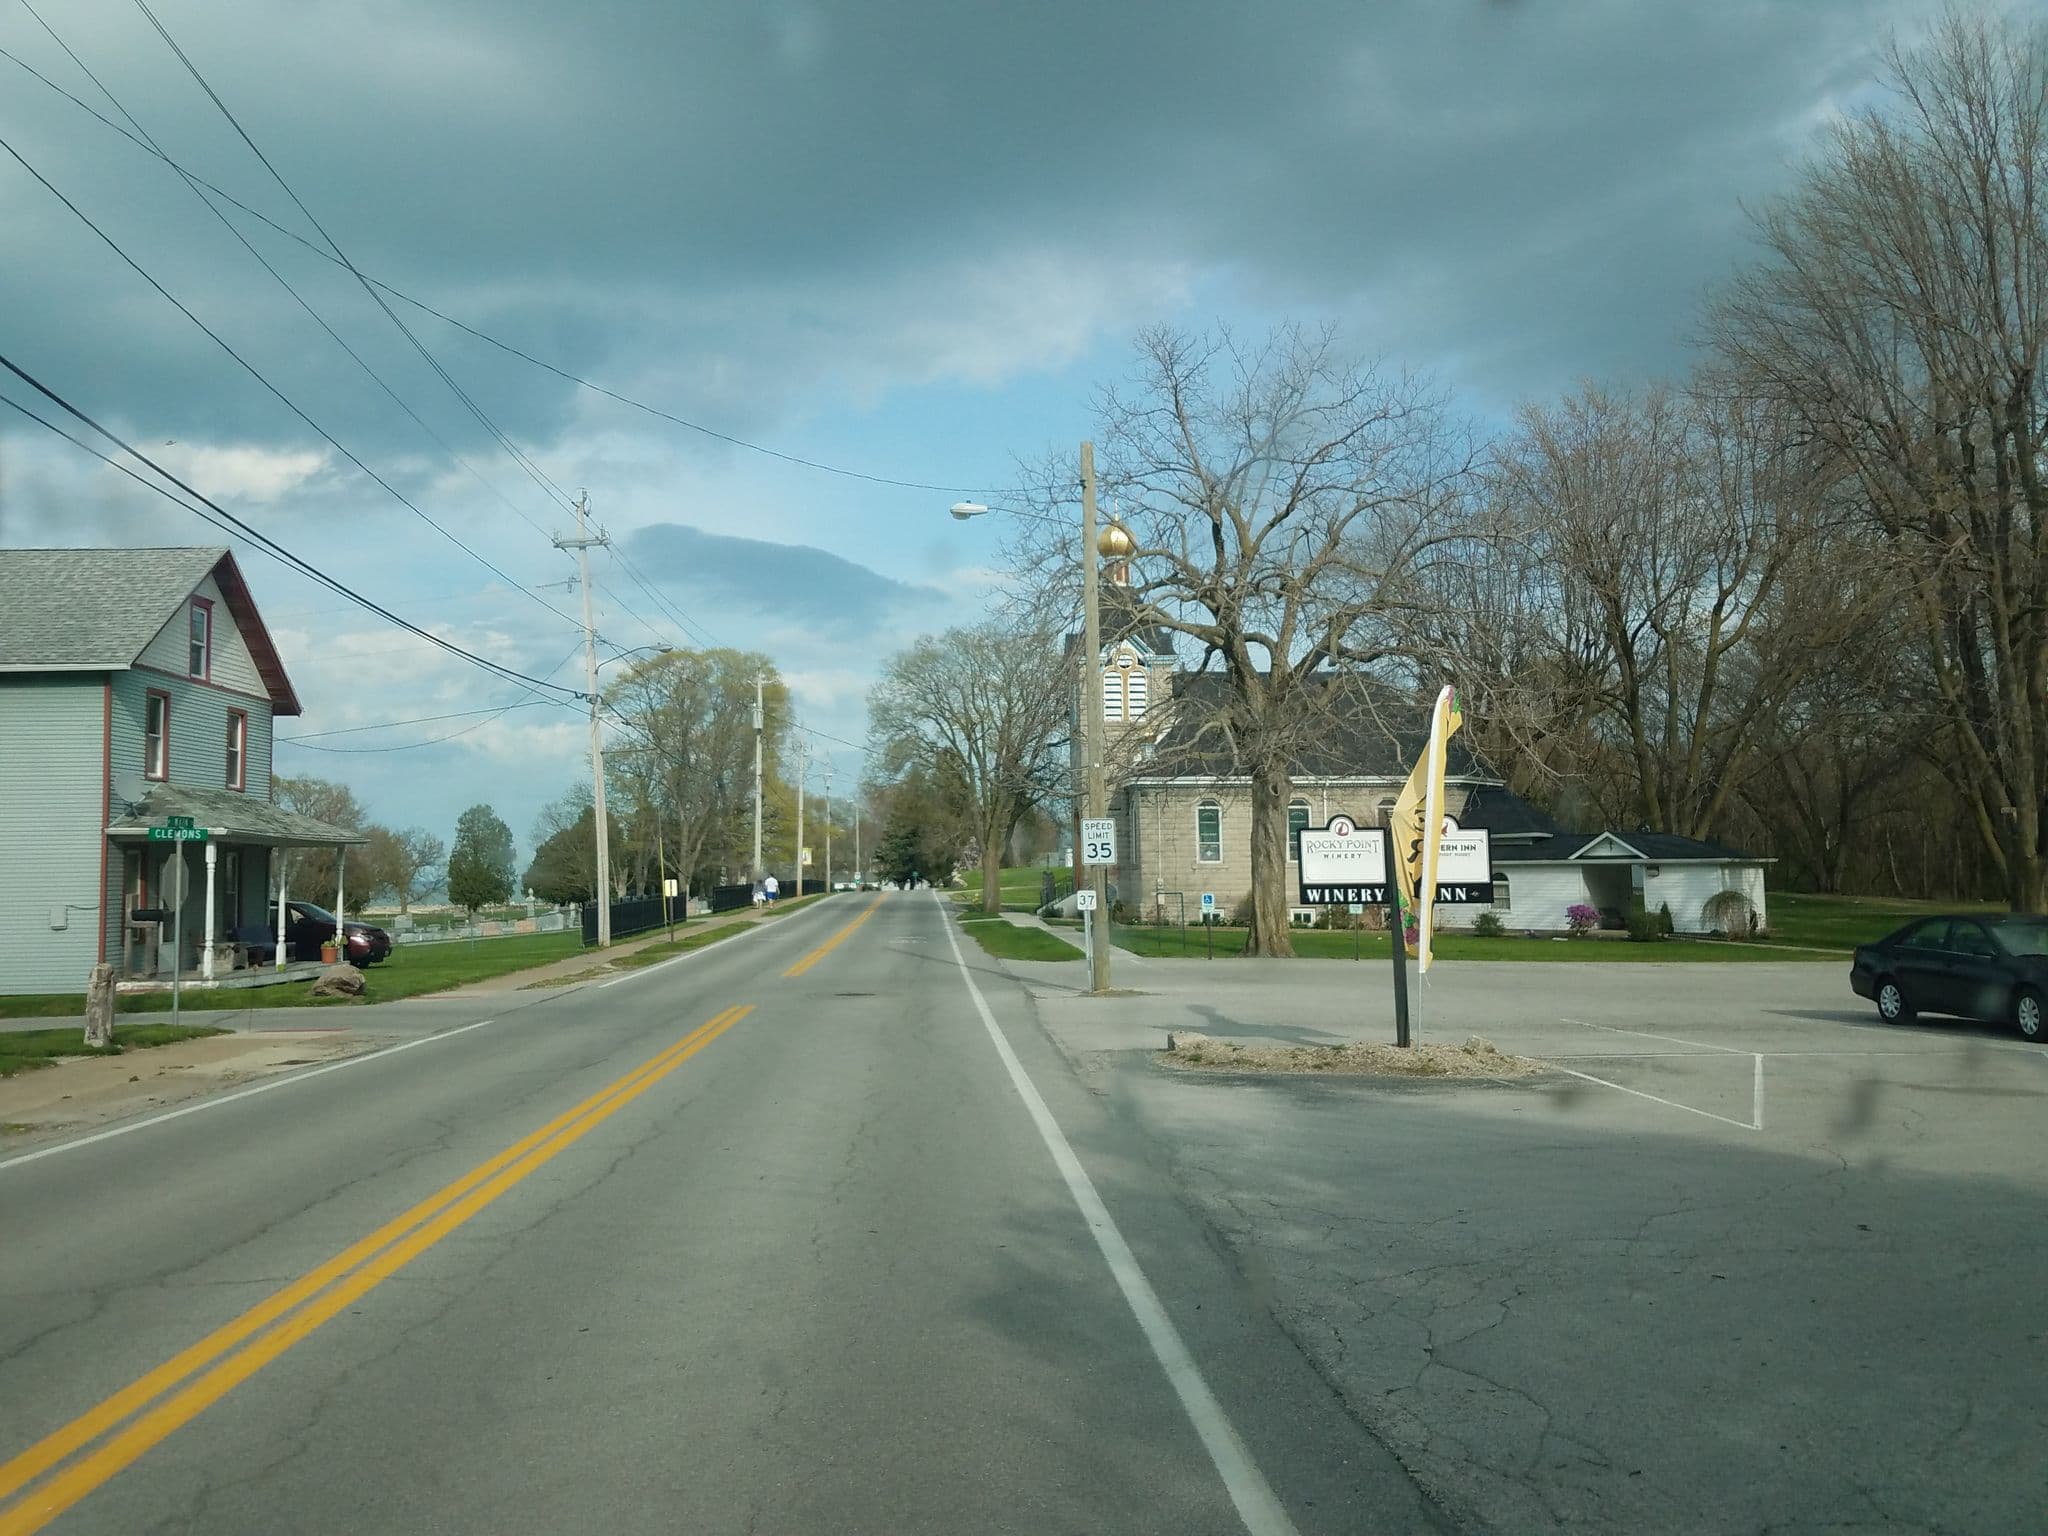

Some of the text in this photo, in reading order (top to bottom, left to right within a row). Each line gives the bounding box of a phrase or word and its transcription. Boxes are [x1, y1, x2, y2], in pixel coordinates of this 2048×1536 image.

[1084, 822, 1112, 830] SPEED
[155, 829, 201, 839] CLEMONS
[1087, 843, 1112, 858] 35
[1306, 840, 1379, 853] ROCKY POINT
[1440, 844, 1477, 852] ERN INN
[1306, 888, 1385, 902] WINERY
[1439, 887, 1467, 901] NN
[1079, 895, 1094, 906] 37
